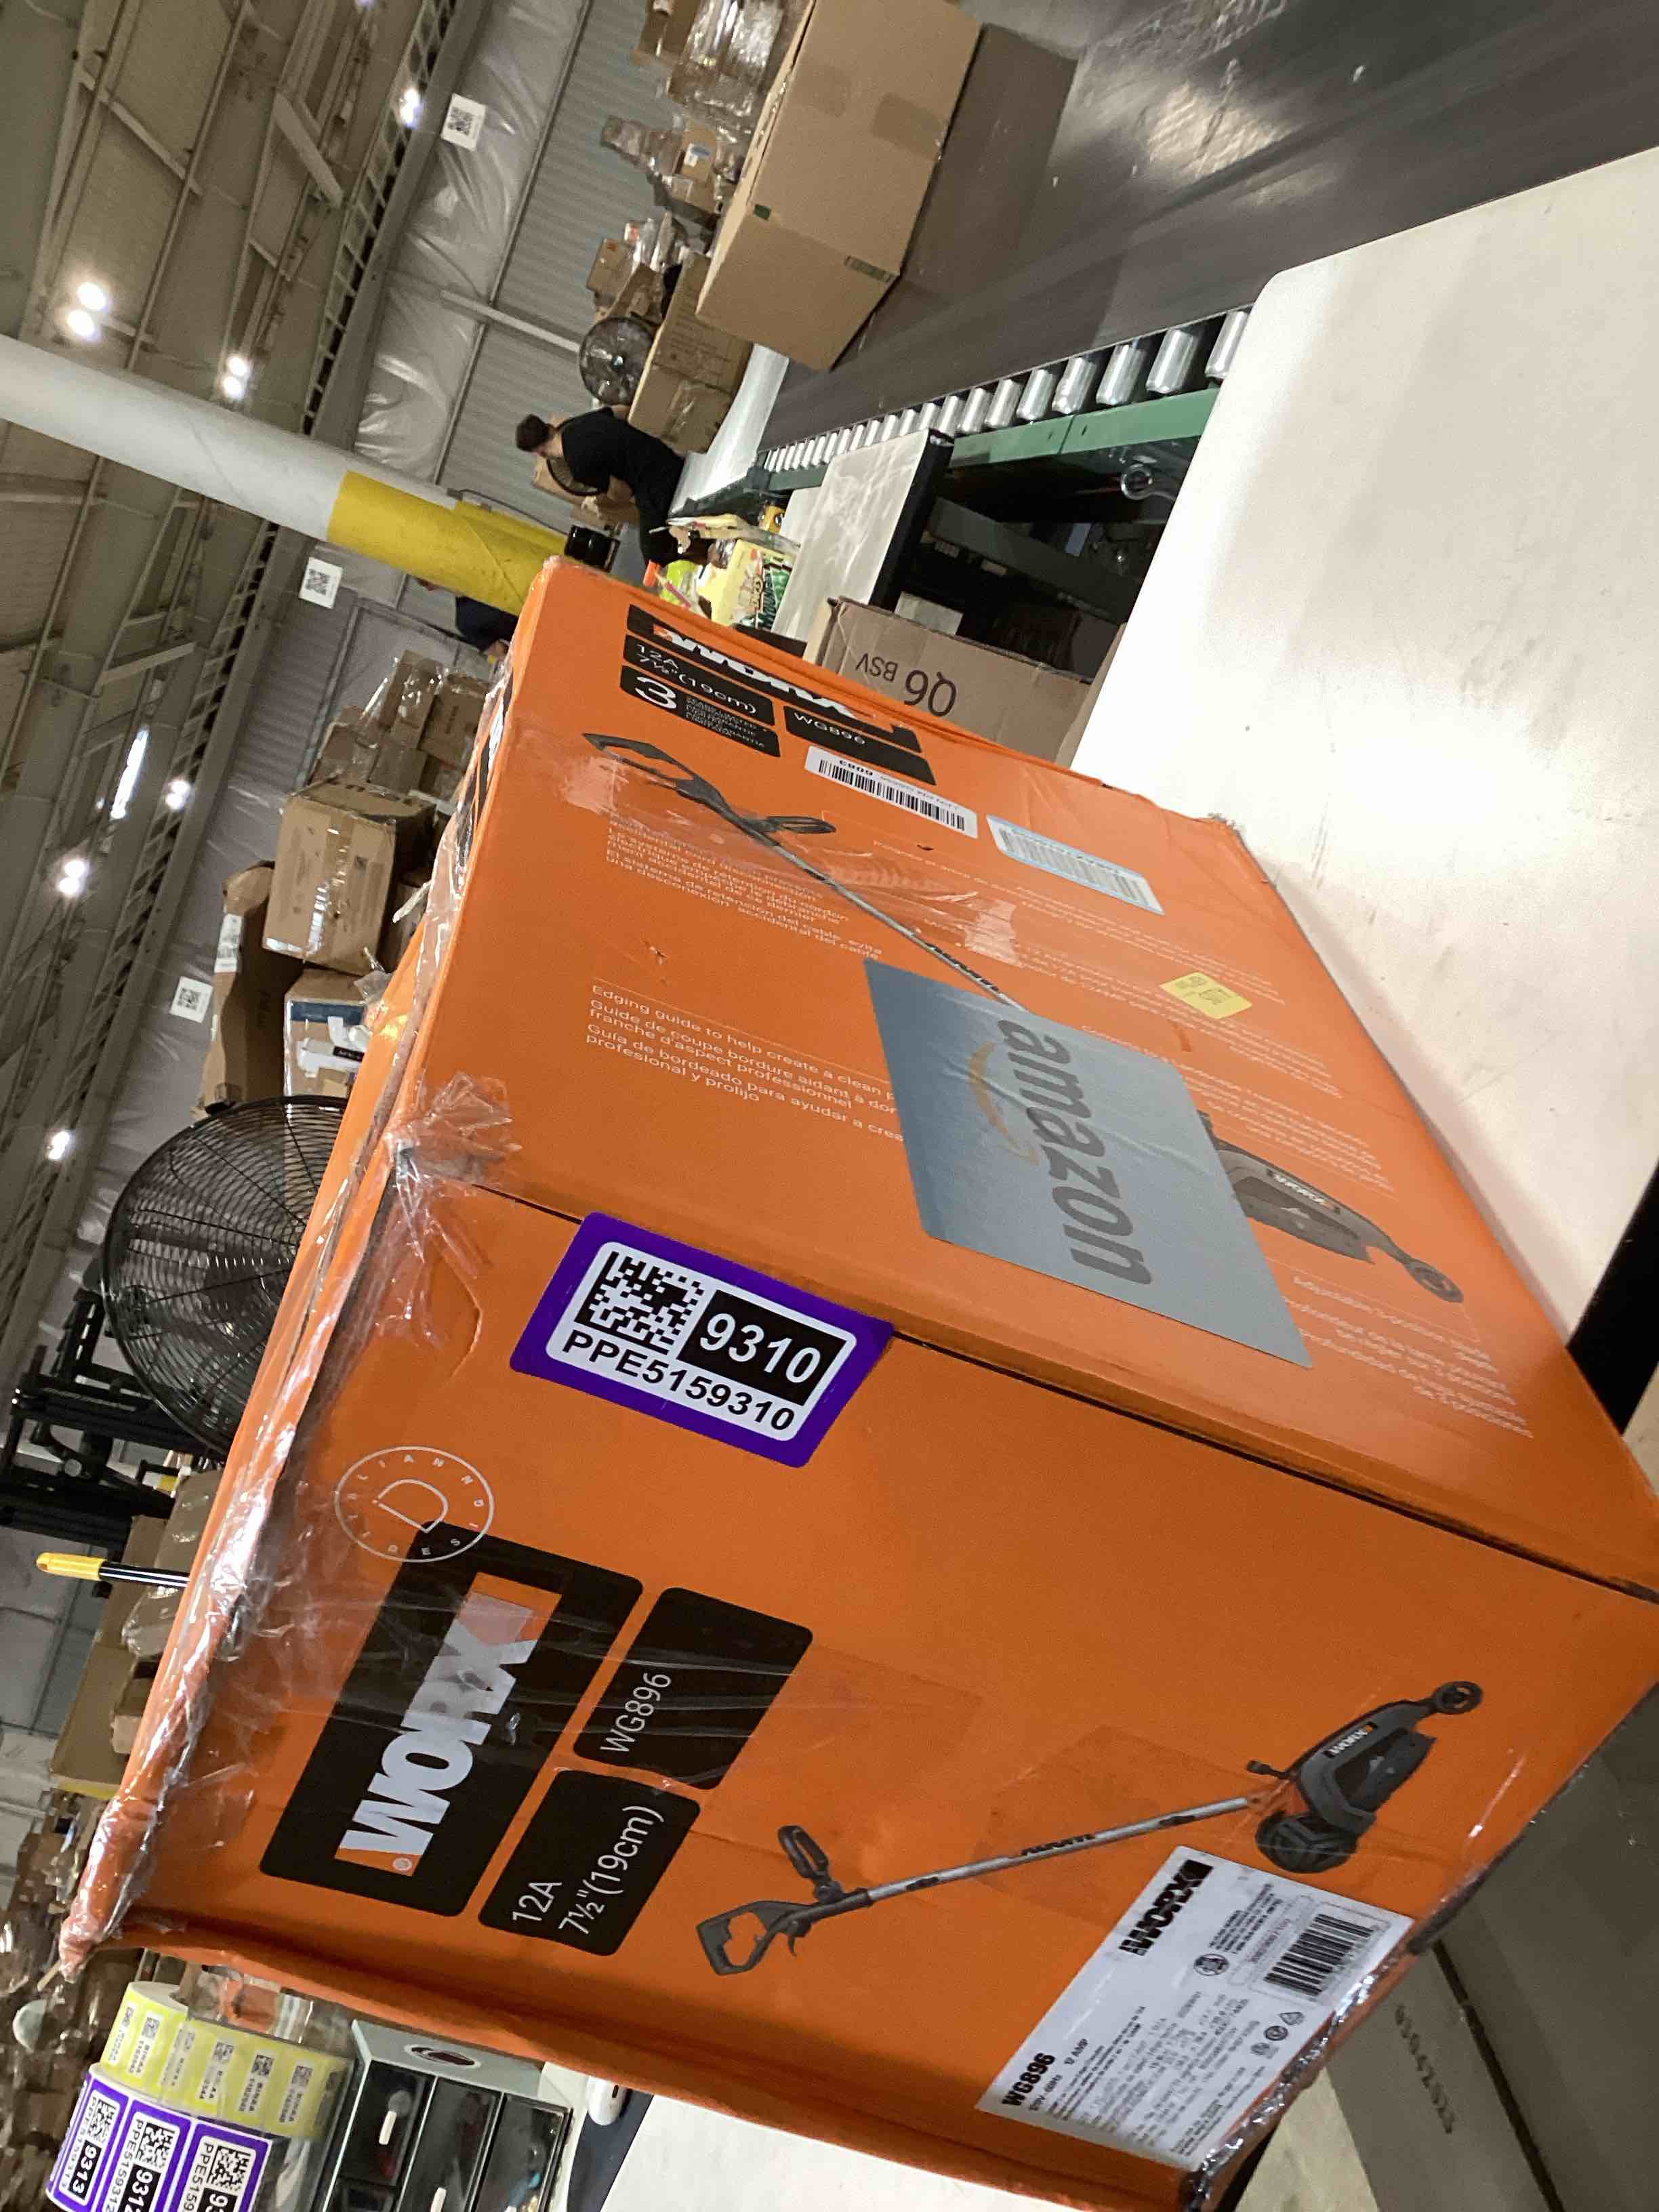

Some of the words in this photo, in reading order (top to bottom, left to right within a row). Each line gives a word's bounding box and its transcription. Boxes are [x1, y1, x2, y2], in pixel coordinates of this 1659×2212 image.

[636, 643, 678, 670] 12A
[855, 653, 899, 682] BSV
[635, 676, 677, 710] 3
[903, 669, 957, 717] Q6
[590, 998, 641, 1025] Guide
[644, 1018, 664, 1034] de
[592, 984, 650, 1016] Edging
[655, 1008, 701, 1033] guide
[704, 1025, 724, 1041] to
[725, 1033, 762, 1055] help
[766, 1048, 820, 1076] create
[835, 1071, 884, 1097] clean
[586, 1033, 687, 1079] profesional
[691, 1071, 700, 1084] y
[590, 1007, 655, 1040] franche
[735, 1061, 853, 1110] professionnel
[632, 1038, 653, 1055] de
[746, 1080, 787, 1105] para
[998, 1019, 1152, 1284] amazon
[561, 1330, 796, 1431] PPE5159310
[699, 1312, 821, 1383] 9310
[339, 1618, 539, 1856] WORX
[600, 1671, 672, 1755] WG896
[512, 1880, 562, 1923] 12A
[1001, 2052, 1056, 2106] WG896
[1119, 1864, 1208, 1953] WORX
[72, 2144, 98, 2194] 9313
